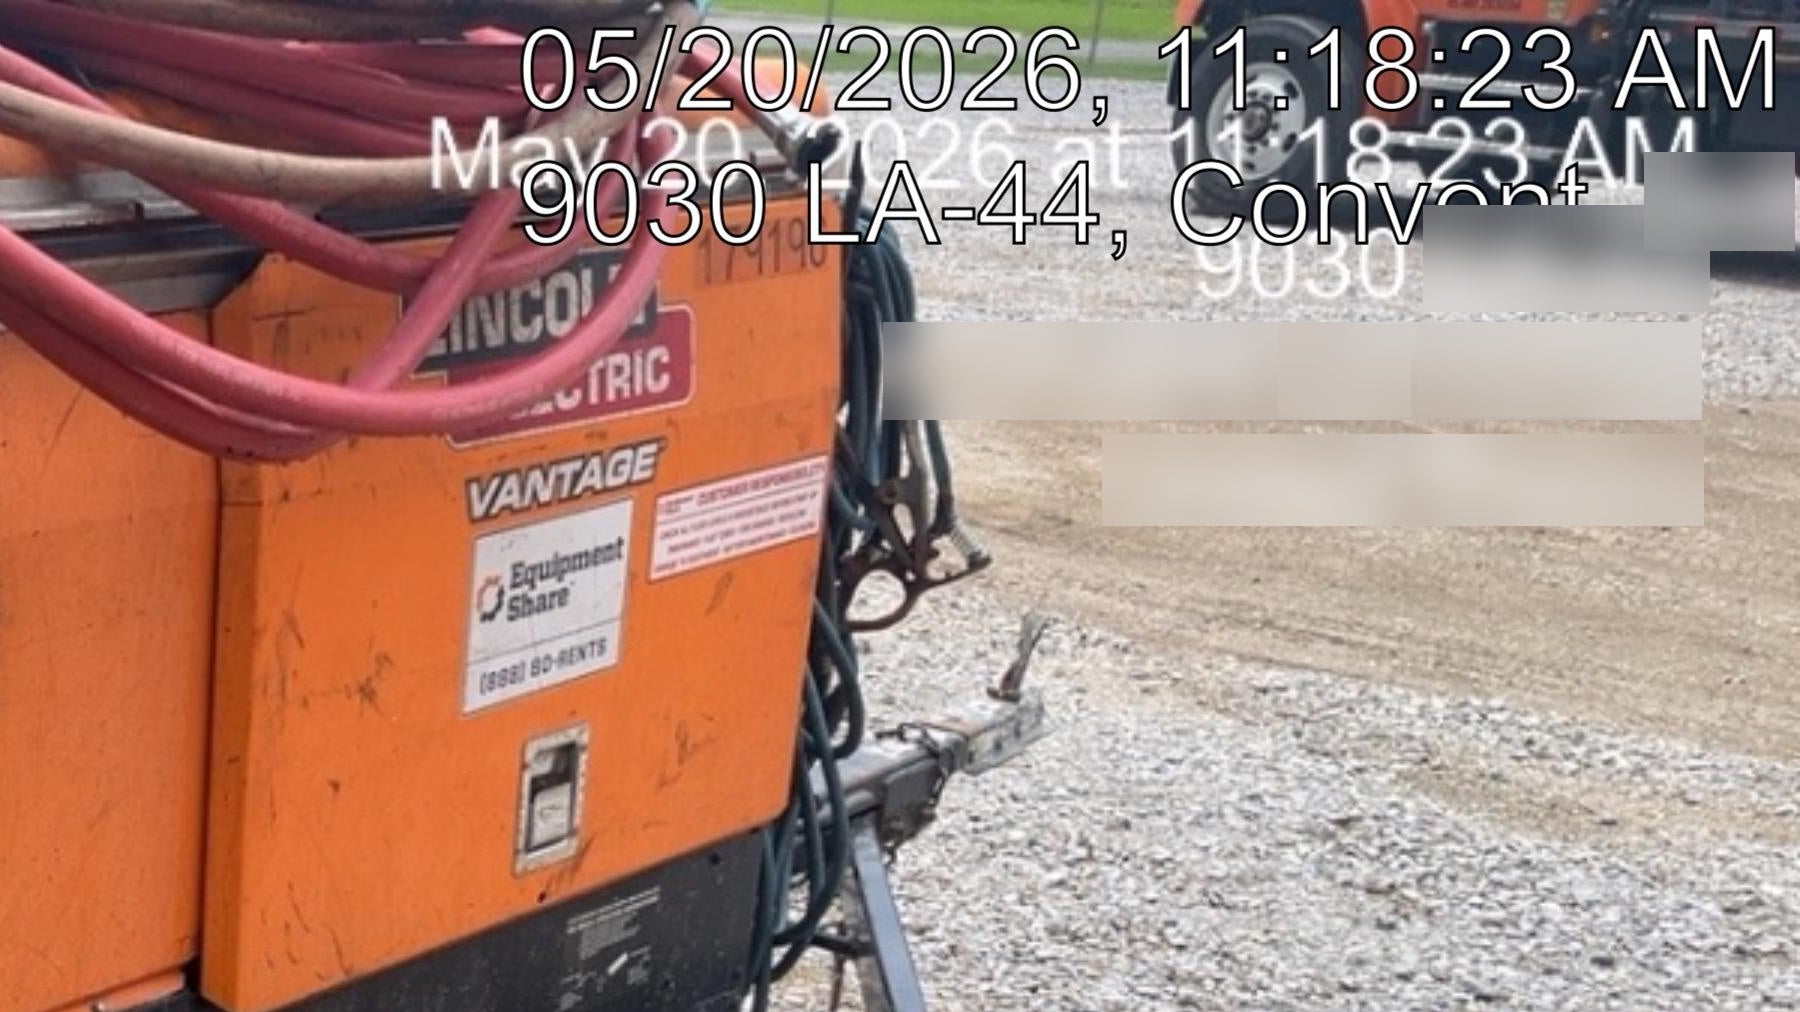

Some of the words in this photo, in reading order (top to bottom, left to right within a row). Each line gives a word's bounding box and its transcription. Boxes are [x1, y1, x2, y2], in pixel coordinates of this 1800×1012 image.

[422, 263, 650, 356] INCOL
[467, 442, 660, 521] VANTAGE
[509, 536, 624, 592] Equipment
[506, 586, 571, 622] Share
